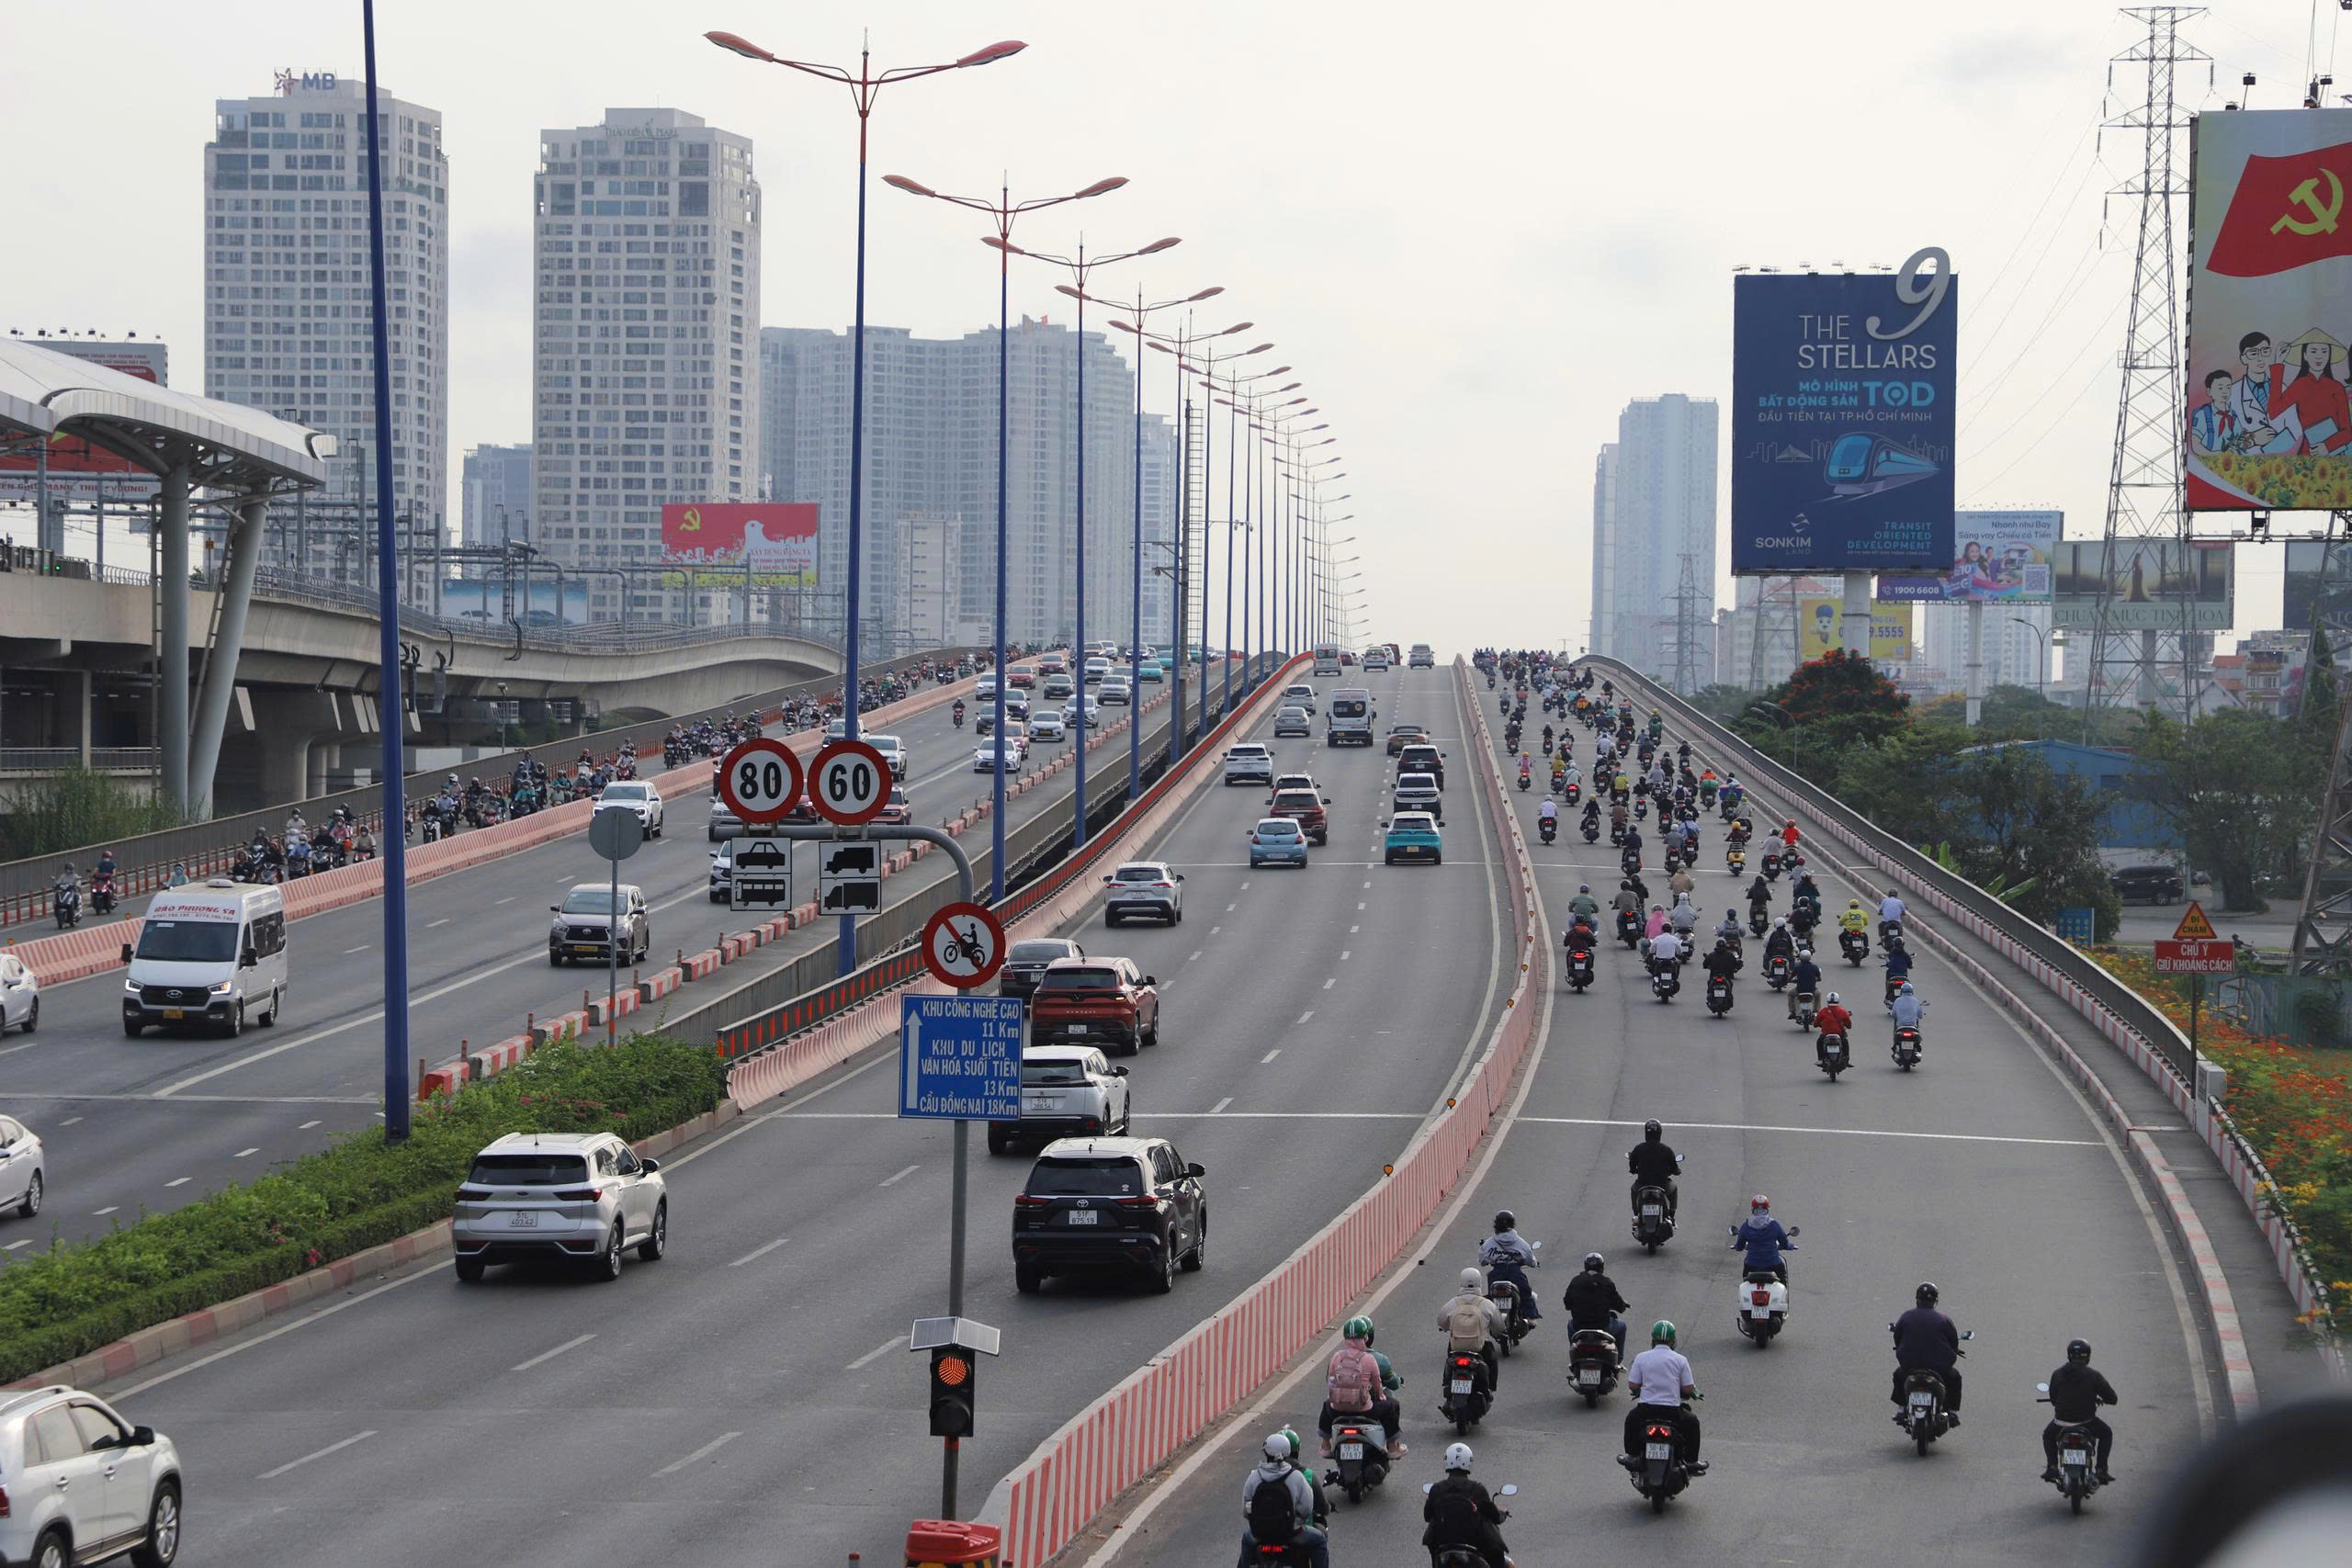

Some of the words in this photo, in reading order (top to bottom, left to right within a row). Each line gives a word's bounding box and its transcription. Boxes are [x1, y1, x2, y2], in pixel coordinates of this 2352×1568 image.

[302, 73, 336, 90] MB
[1866, 246, 1951, 340] 9
[1798, 315, 1849, 340] THE
[1797, 344, 1937, 369] STELLARS
[1799, 378, 1820, 391] MÔ
[1825, 378, 1858, 391] HÌNH
[1758, 392, 1783, 407] BẤT
[1787, 394, 1827, 410] ĐỘNG
[1831, 393, 1858, 406] SẢN
[1862, 381, 1935, 406] TOD
[1788, 411, 1814, 422] TIÊN
[1819, 412, 1836, 423] TẠI
[1877, 410, 1898, 422] CHÍ
[1901, 412, 1932, 422] MINH
[1883, 521, 1932, 531] TRANSIT
[1991, 521, 2018, 529] Nhanh
[2019, 521, 2034, 529] như
[2035, 520, 2051, 530] Bay
[1755, 536, 1811, 548] SONKIM
[1874, 531, 1931, 540] ORIENTED
[1981, 533, 1995, 541] vay
[1847, 540, 1931, 550] DEVELOPMENT
[1894, 586, 1915, 594] 1900
[1917, 586, 1939, 594] 6608
[740, 761, 782, 800] 80
[829, 763, 871, 802] 60
[2190, 916, 2199, 924] ĐI
[2181, 942, 2199, 956] CHÚ
[2202, 942, 2209, 956] Ý
[2173, 957, 2207, 971] KHOẢNG
[2209, 957, 2232, 971] CÁCH
[922, 1000, 943, 1017] KHU
[944, 998, 970, 1018] CÔNG
[972, 999, 999, 1021] NGHỆ
[1000, 1003, 1019, 1020] CAO
[982, 1021, 994, 1038] 11
[999, 1021, 1019, 1038] Km
[932, 1039, 955, 1055] KHU
[961, 1040, 975, 1055] DU
[982, 1041, 1005, 1059] LỊCH
[921, 1056, 939, 1075] VĂN
[942, 1056, 962, 1076] HÓA
[964, 1056, 988, 1077] SUỐI
[992, 1057, 1017, 1077] TIÊN
[983, 1080, 996, 1096] 13
[998, 1080, 1018, 1097] Km
[920, 1090, 939, 1112] CẦU
[940, 1091, 967, 1113] ĐỒNG
[967, 1098, 985, 1114] NAI
